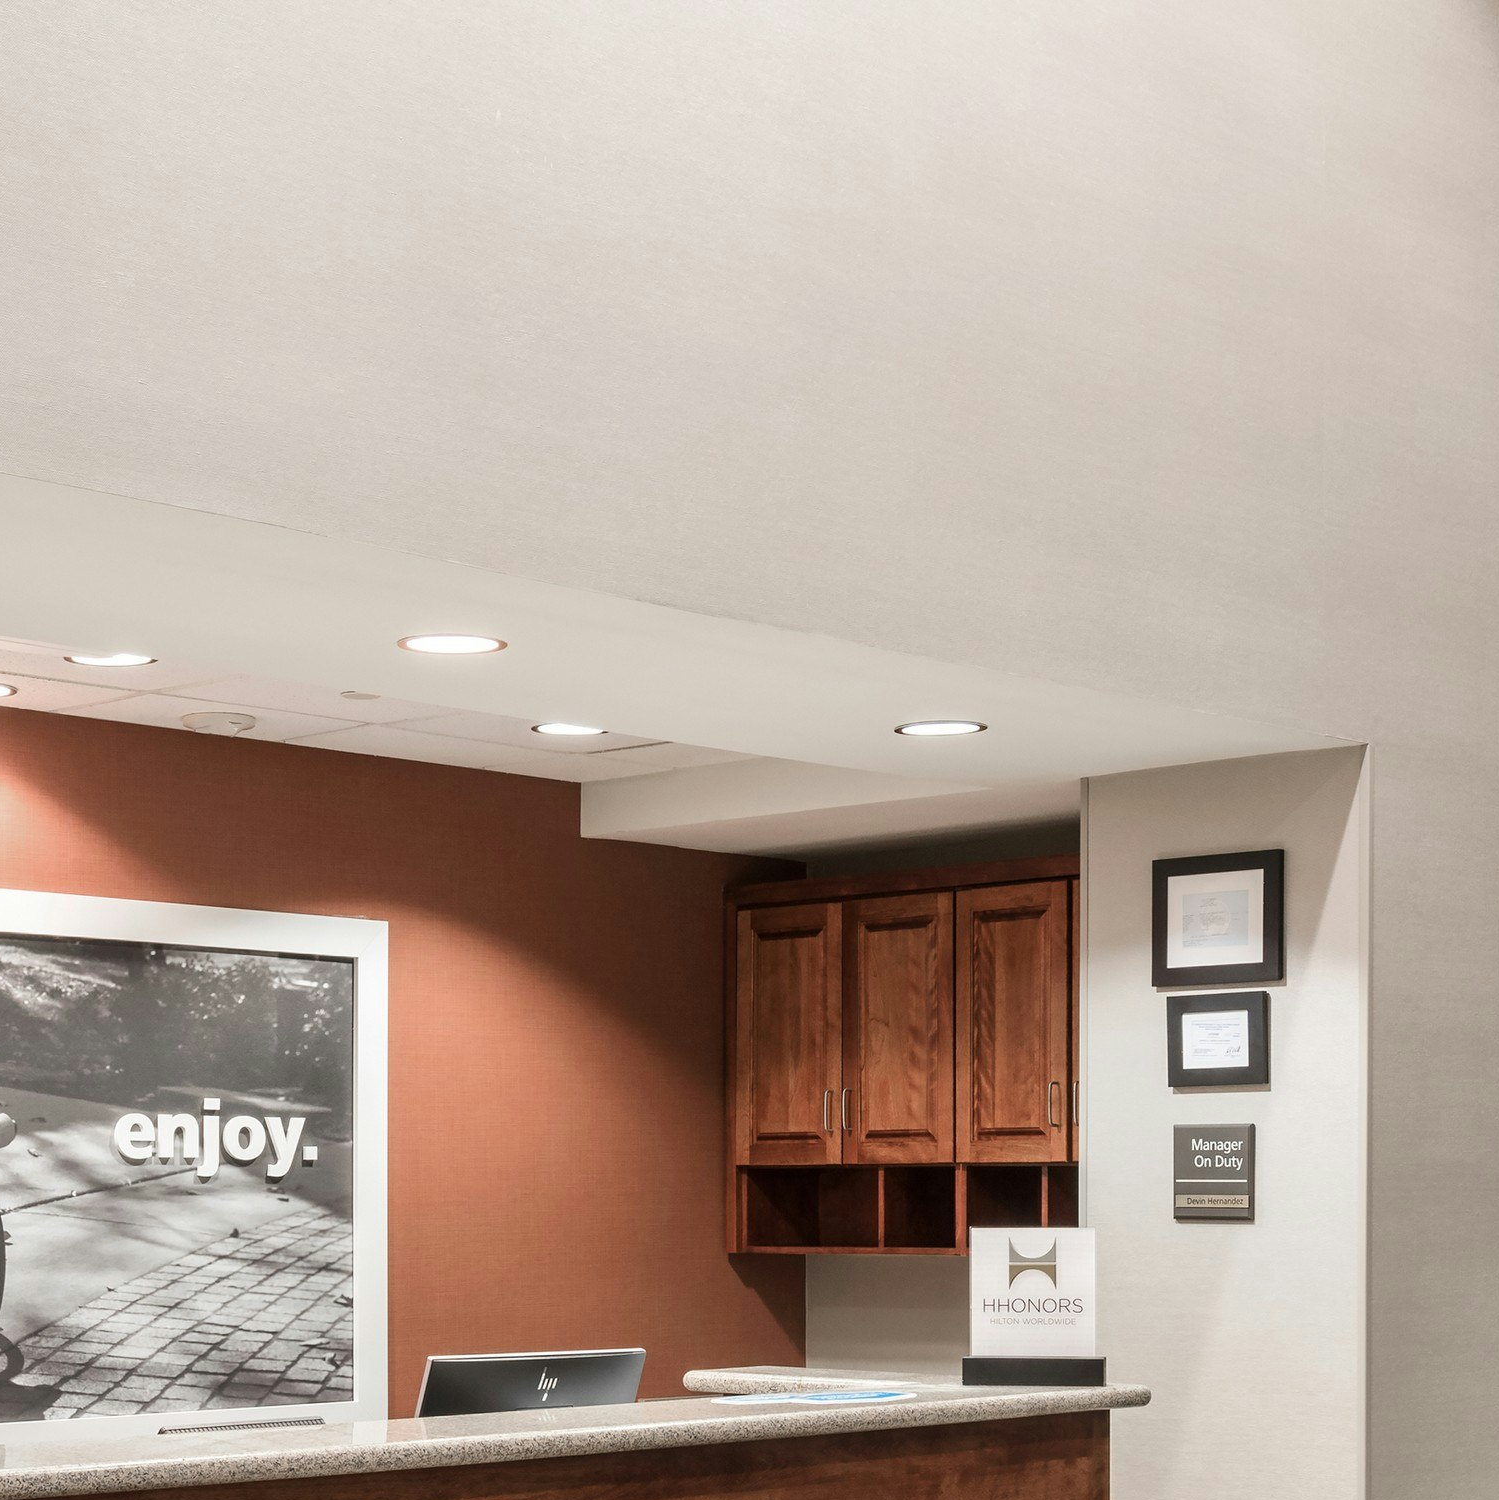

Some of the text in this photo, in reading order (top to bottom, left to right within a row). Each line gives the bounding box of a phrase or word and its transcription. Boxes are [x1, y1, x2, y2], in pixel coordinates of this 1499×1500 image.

[113, 1098, 318, 1180] enjoy.
[1191, 1138, 1244, 1154] Manager
[1194, 1155, 1244, 1170] On Duty
[1186, 1197, 1244, 1205] Devin Hernandez
[983, 1298, 1084, 1314] HHONORS
[1022, 1318, 1076, 1326] WORLDWIDE
